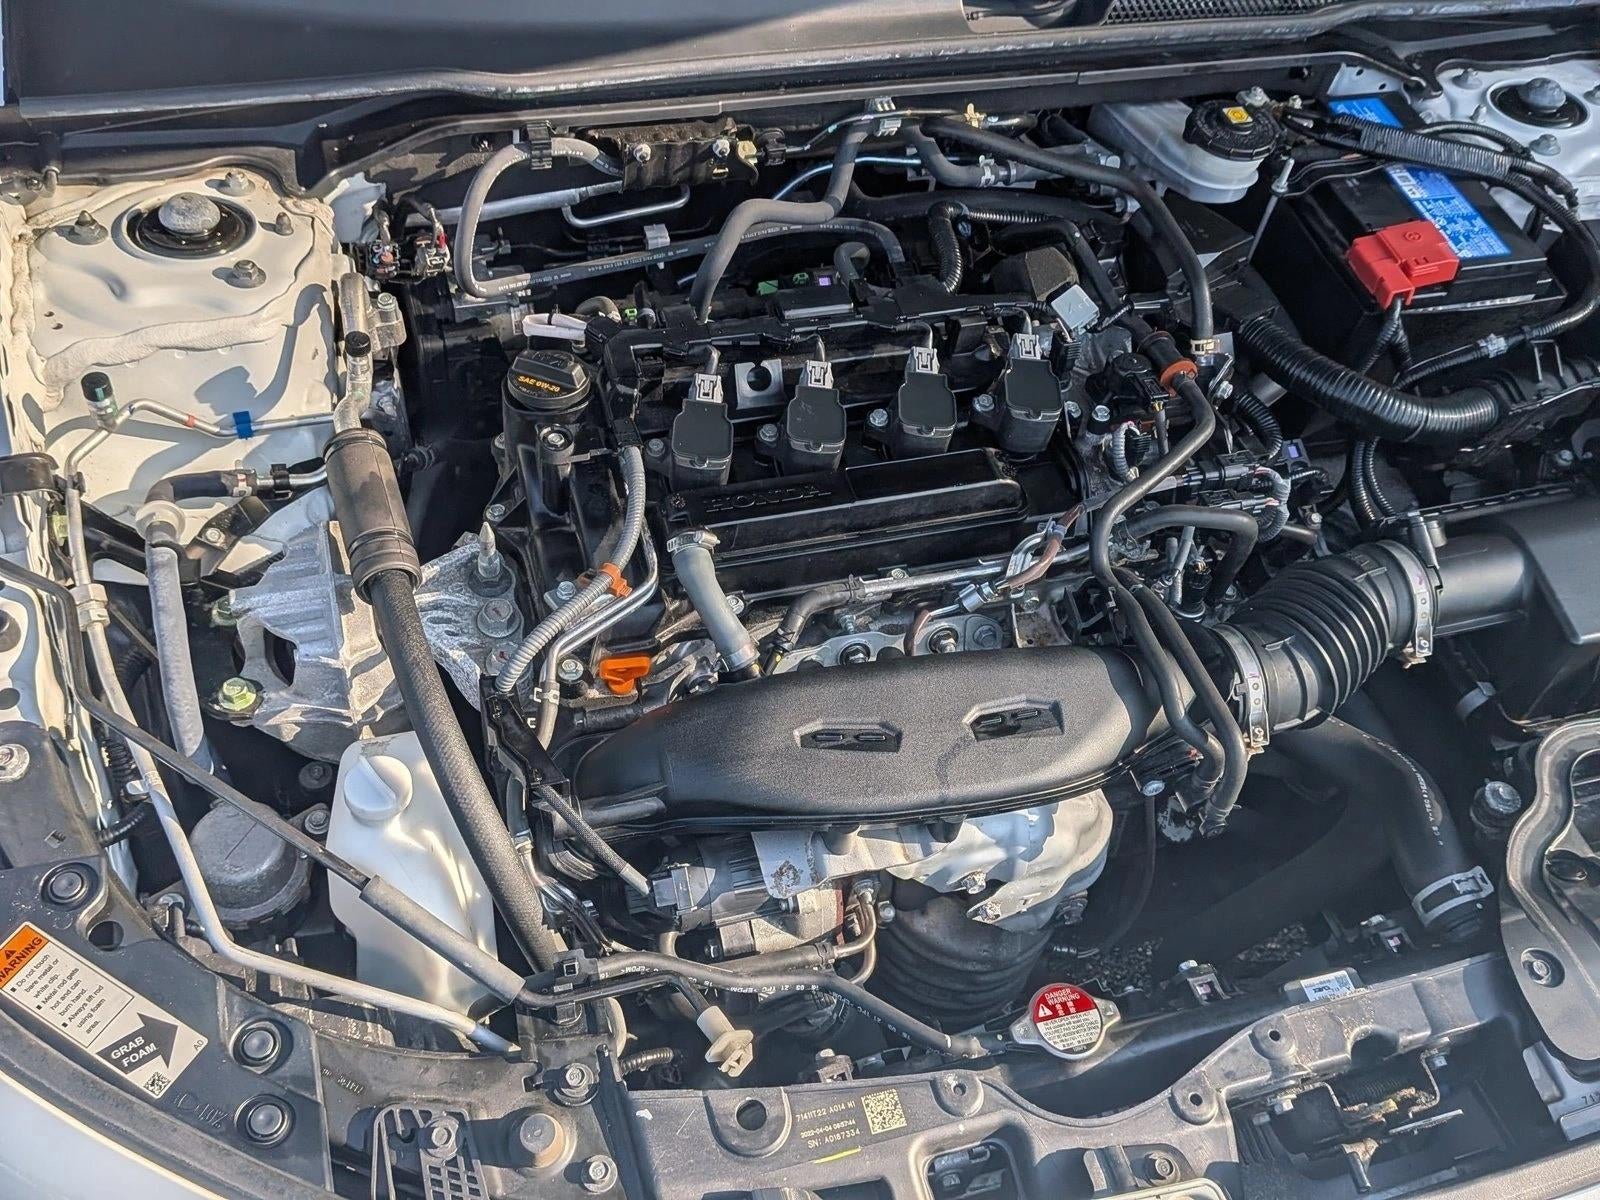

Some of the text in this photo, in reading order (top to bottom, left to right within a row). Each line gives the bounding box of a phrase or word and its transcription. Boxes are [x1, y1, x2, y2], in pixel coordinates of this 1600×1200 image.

[518, 375, 537, 385] SAE
[536, 381, 560, 392] 0W-20
[705, 485, 832, 512] HONDA
[16, 954, 50, 988] Do not touch
[24, 980, 38, 993] bare
[38, 964, 54, 980] metal
[33, 984, 49, 998] white
[41, 968, 80, 1004] Metal rod gets
[50, 980, 82, 1011] hot and can
[1044, 987, 1072, 1001] DANGER
[59, 1003, 73, 1016] burn
[68, 984, 104, 1022] Always lift rod
[77, 998, 106, 1028] using foam
[110, 1036, 145, 1060] GRAB
[121, 1042, 157, 1067] FOAM
[807, 1138, 822, 1149] SN:
